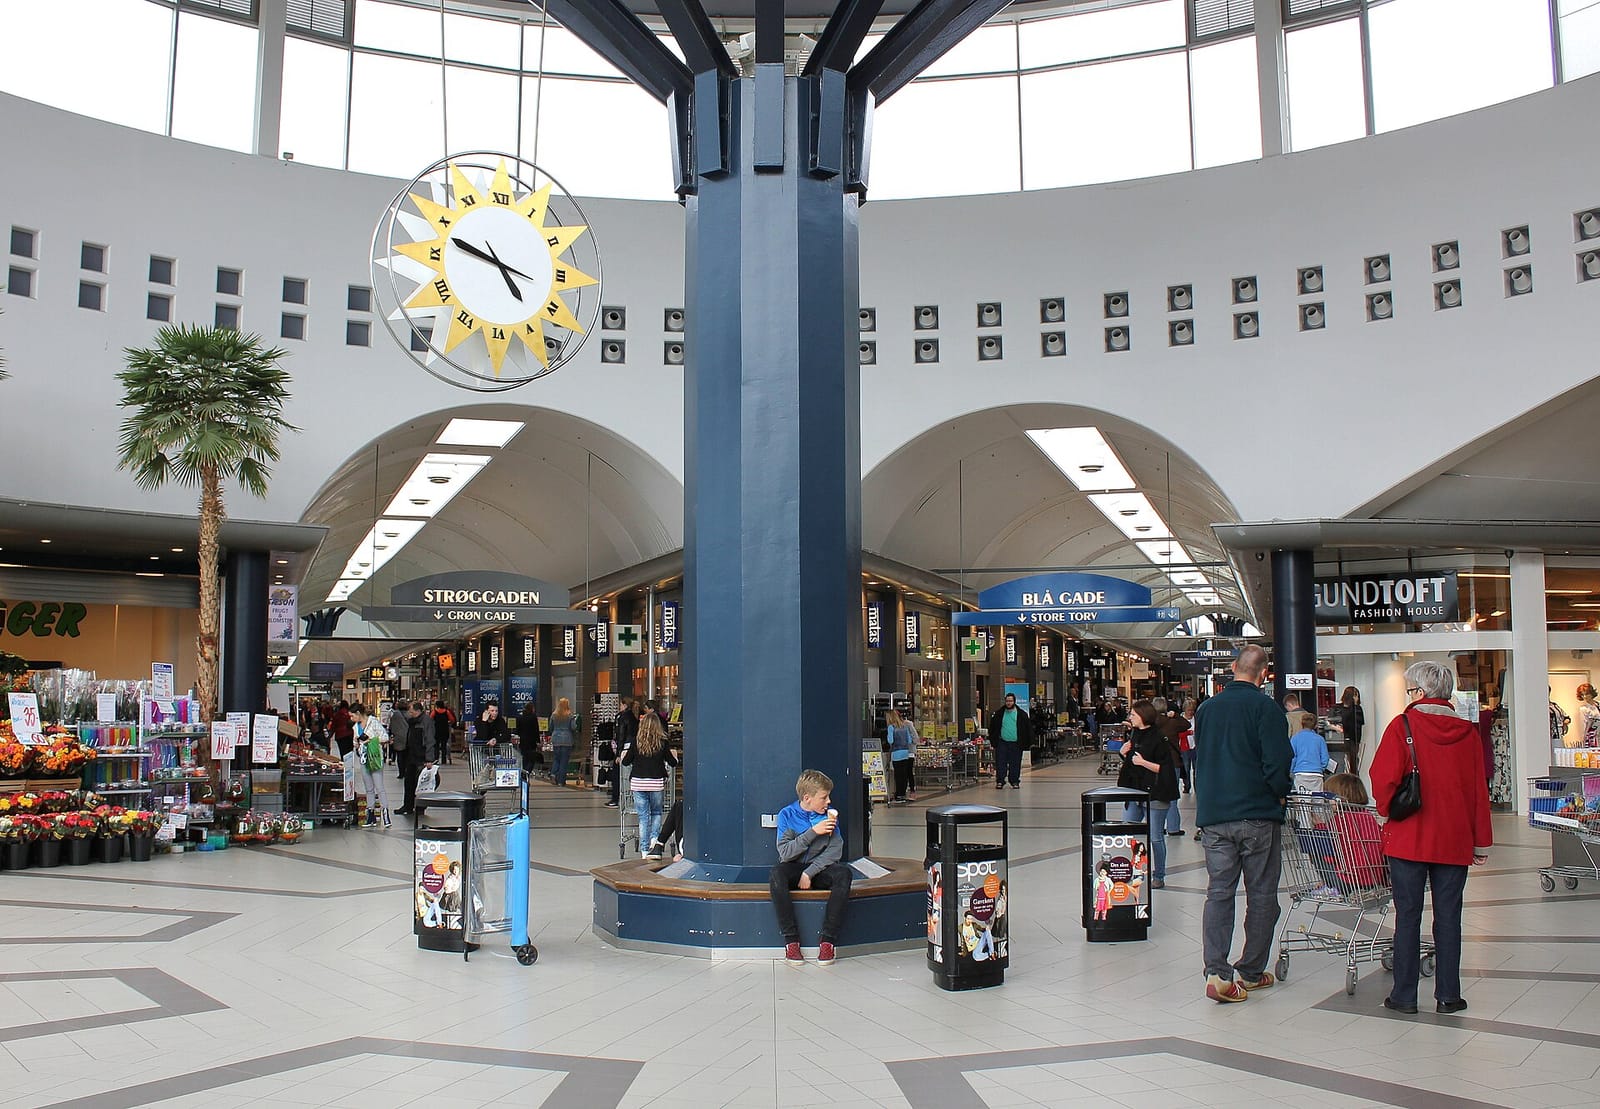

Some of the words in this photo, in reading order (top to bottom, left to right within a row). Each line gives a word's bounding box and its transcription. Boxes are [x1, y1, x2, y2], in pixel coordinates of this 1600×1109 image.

[461, 194, 476, 208] XI
[492, 192, 509, 206] XII
[527, 207, 537, 219] I
[439, 215, 451, 228] X
[547, 236, 560, 247] II
[430, 247, 441, 262] IX
[556, 269, 566, 283] III
[434, 278, 451, 303] VIII
[547, 301, 560, 316] IV
[457, 310, 474, 329] VII
[492, 327, 506, 340] VI
[525, 323, 535, 334] V
[423, 589, 540, 605] STRØGGADEN
[1022, 589, 1054, 606] BLÅ
[1059, 591, 1105, 605] GADE
[447, 610, 481, 621] GRØN
[484, 611, 516, 621] GADE
[1031, 612, 1065, 622] STORE
[1068, 611, 1098, 621] TORV
[1354, 607, 1402, 618] FASHION
[1407, 606, 1444, 616] HOUSE
[0, 601, 87, 638] GER
[664, 607, 677, 643] matas
[869, 607, 881, 643] matas
[597, 622, 609, 654] matas
[906, 616, 918, 649] matas
[465, 689, 473, 714] matas
[480, 693, 499, 701] -30%
[511, 692, 533, 701] -30%
